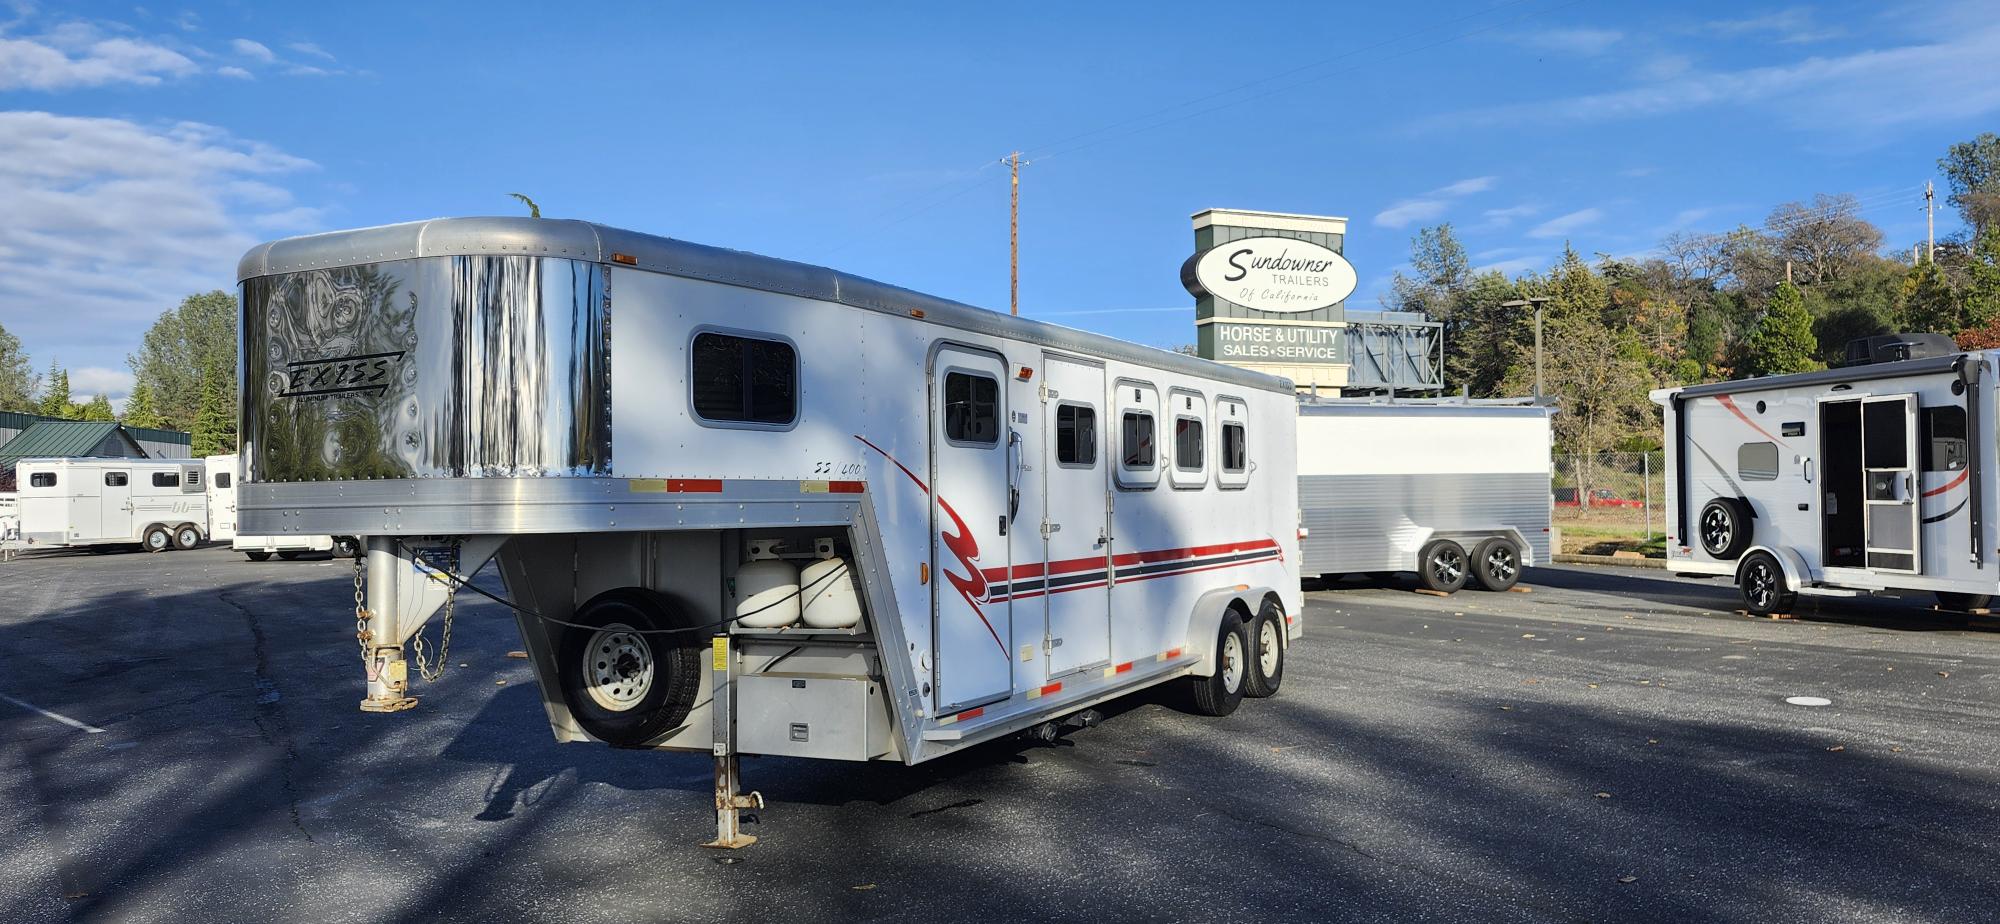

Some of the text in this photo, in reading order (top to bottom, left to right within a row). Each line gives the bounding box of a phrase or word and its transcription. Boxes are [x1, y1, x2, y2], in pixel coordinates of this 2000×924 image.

[1224, 248, 1333, 282] Sundowner
[1272, 274, 1329, 287] TRAILERS
[1239, 287, 1319, 303] Of California
[1220, 326, 1338, 345] HORSE & UTILITY
